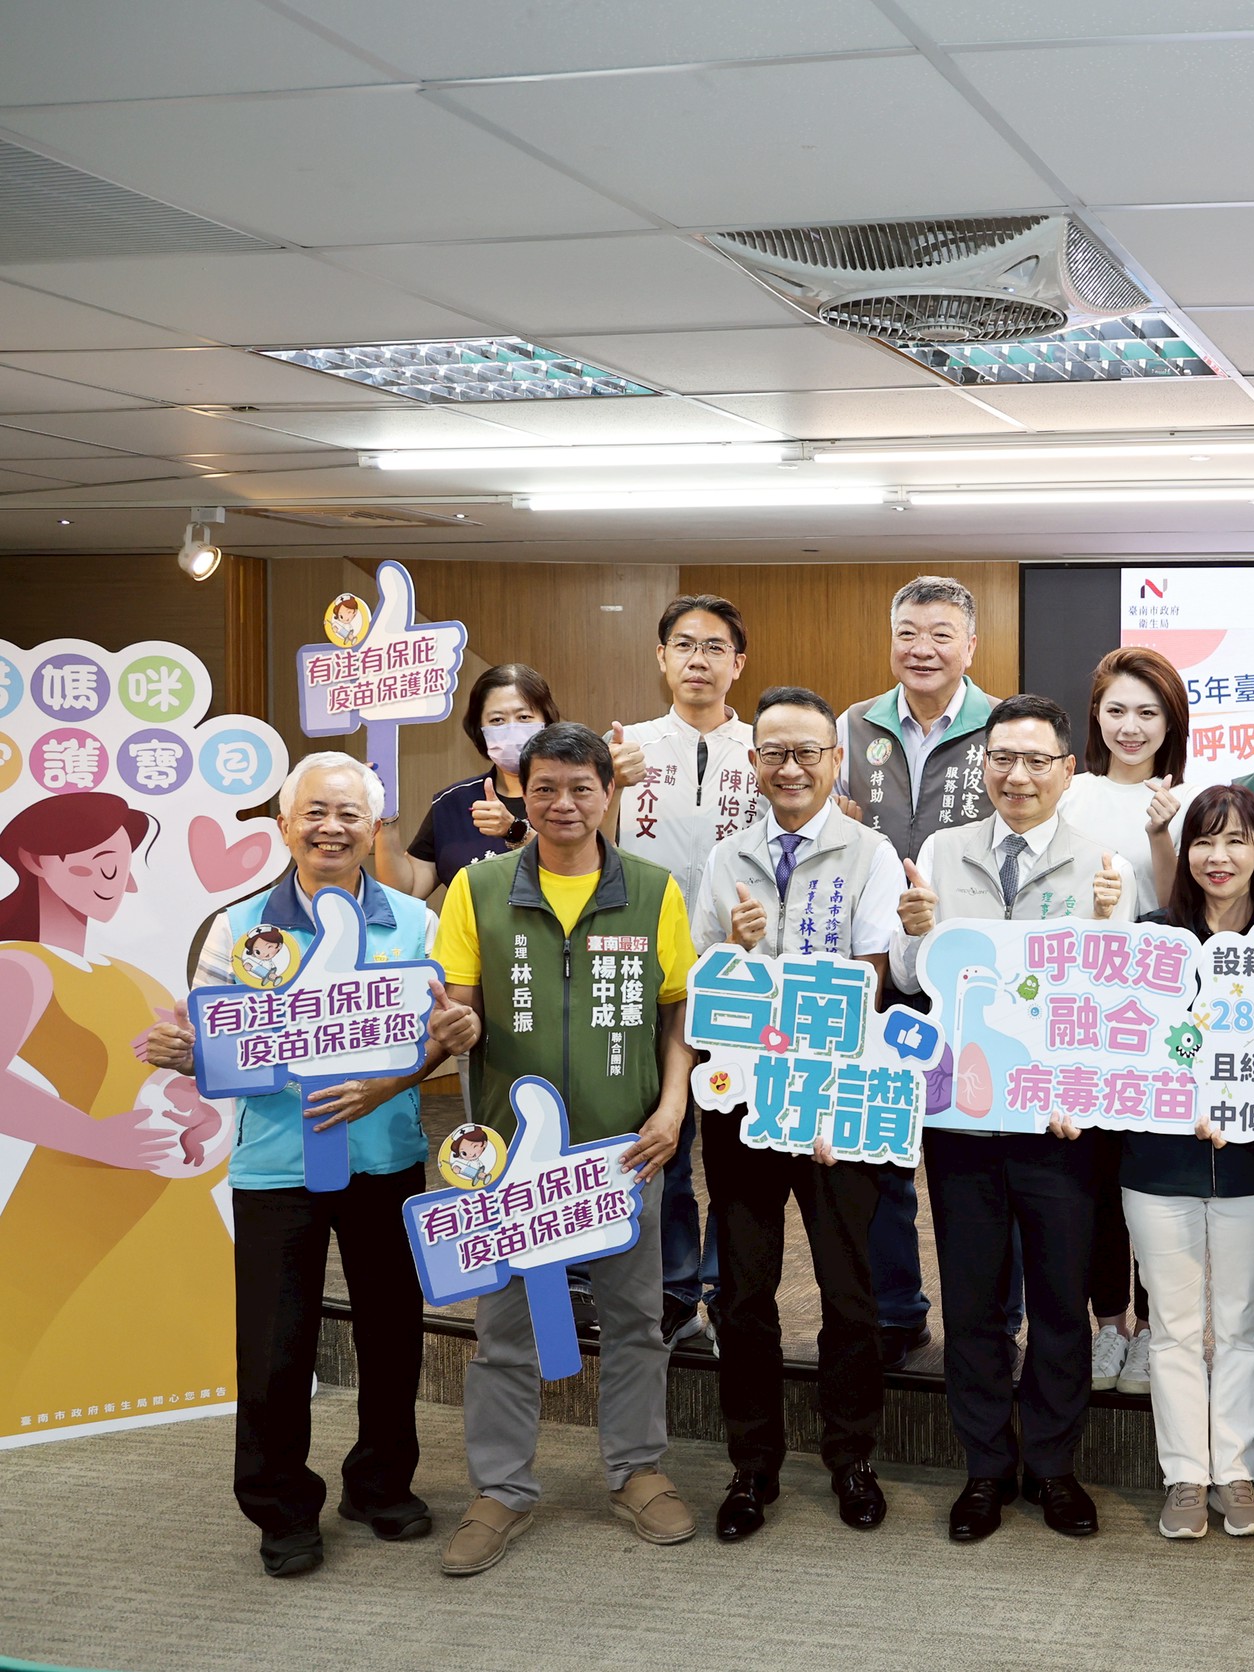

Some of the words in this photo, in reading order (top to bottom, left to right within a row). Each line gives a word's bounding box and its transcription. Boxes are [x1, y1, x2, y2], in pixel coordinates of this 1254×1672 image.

[1128, 605, 1180, 616] 臺南市政府
[1138, 618, 1169, 629] 衛生局
[0, 661, 183, 712] 媽咪
[308, 636, 437, 687] 有注有保庇
[328, 667, 446, 714] 疫苗保護您
[0, 738, 259, 789] 護寶貝
[664, 764, 677, 786] 特助
[869, 769, 885, 803] 特助
[961, 744, 984, 819] 林俊憲
[636, 765, 661, 839] 李介文
[939, 766, 959, 824] 服務團隊
[514, 934, 528, 960] 助理
[1027, 929, 1189, 994] 呼吸道
[205, 976, 402, 1036] 有注有保庇
[511, 963, 534, 1033] 林岳振
[591, 955, 616, 1029] 楊中成
[620, 955, 644, 1028] 林俊憲
[691, 950, 866, 1056] 台南
[239, 1012, 417, 1069] 疫苗保護您
[1048, 996, 1156, 1053] 融合
[609, 1031, 624, 1077] 聯合團隊
[747, 1054, 915, 1156] 好讚
[1006, 1064, 1197, 1121] 病毒疫苗
[421, 1156, 610, 1244] 有注有保庇
[458, 1189, 629, 1270] 疫苗保護您
[20, 1386, 227, 1427] 臺南市政府衛生局關心您廣告
